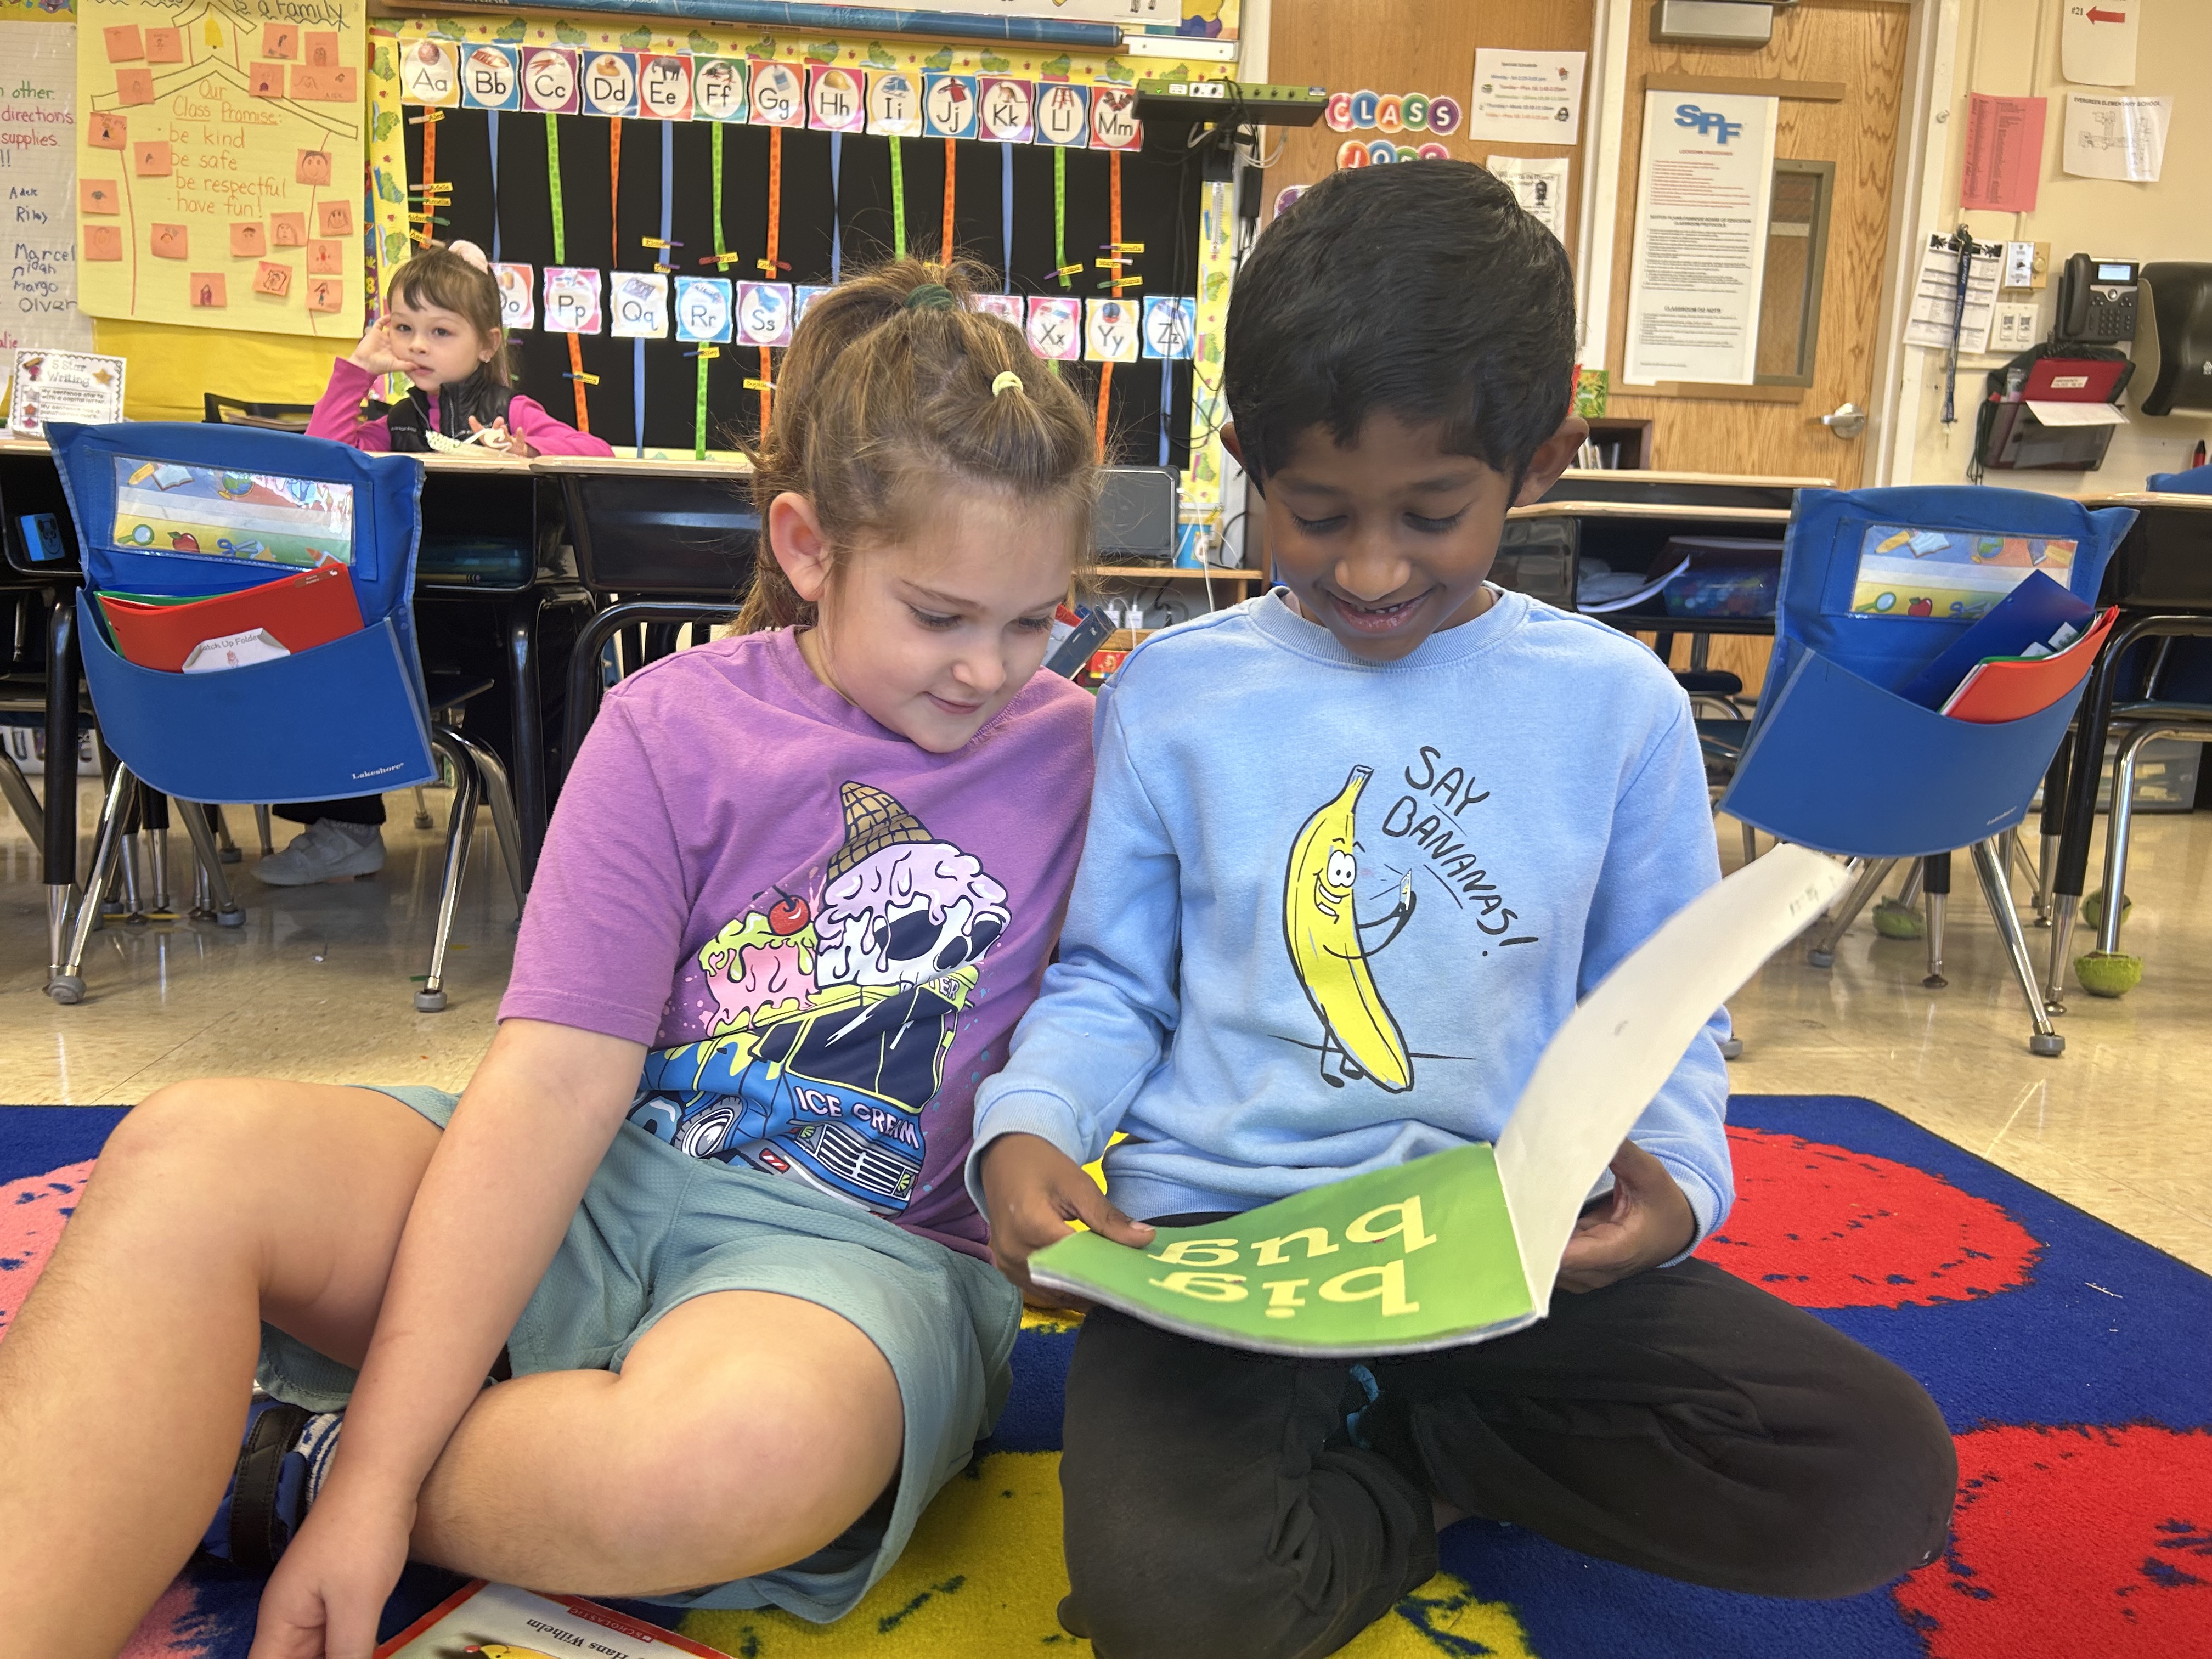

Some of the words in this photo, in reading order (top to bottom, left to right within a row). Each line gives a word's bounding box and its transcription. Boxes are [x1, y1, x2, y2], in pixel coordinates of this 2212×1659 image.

[2072, 7, 2083, 15] #21
[12, 80, 55, 100] other.
[199, 79, 227, 98] Our
[412, 68, 448, 93] Aa
[475, 70, 506, 95] Bb
[534, 75, 566, 98] Cc
[594, 77, 627, 102] Dd
[650, 81, 676, 105] Ee
[706, 84, 731, 106] Ff
[758, 87, 790, 120] Gg
[820, 92, 849, 116] Hh
[2074, 97, 2101, 105] EVERGREEN
[173, 94, 211, 118] Class
[222, 101, 283, 123] Promise:
[884, 97, 902, 120] Ii
[936, 102, 960, 133] Jj
[992, 103, 1020, 128] Kk
[1333, 100, 1450, 126] CLASS
[1052, 111, 1070, 132] Ll
[1098, 113, 1133, 137] Mm
[1674, 104, 1742, 144] SPF
[170, 122, 189, 143] be
[204, 125, 245, 148] kind
[171, 144, 189, 167] be
[199, 150, 238, 171] safe
[176, 169, 195, 190] be
[204, 177, 286, 199] respectful
[177, 190, 215, 214] have
[224, 196, 262, 218] fun!
[558, 295, 586, 326] Pp
[622, 301, 658, 331] Qq
[691, 305, 716, 327] Rr
[752, 309, 775, 332] Ss
[1039, 323, 1065, 346] Xx
[1098, 325, 1124, 356] Yy
[1156, 323, 1180, 345] Zz
[47, 370, 90, 388] Writing
[61, 360, 86, 373] Star
[1406, 746, 1491, 816] SAY
[1382, 795, 1538, 957] BANANAS!
[795, 1086, 843, 1117] ICE
[851, 1102, 921, 1150] CREAM
[526, 1618, 585, 1647] Wilhelm
[571, 1607, 643, 1639] SCHOLASTIC
